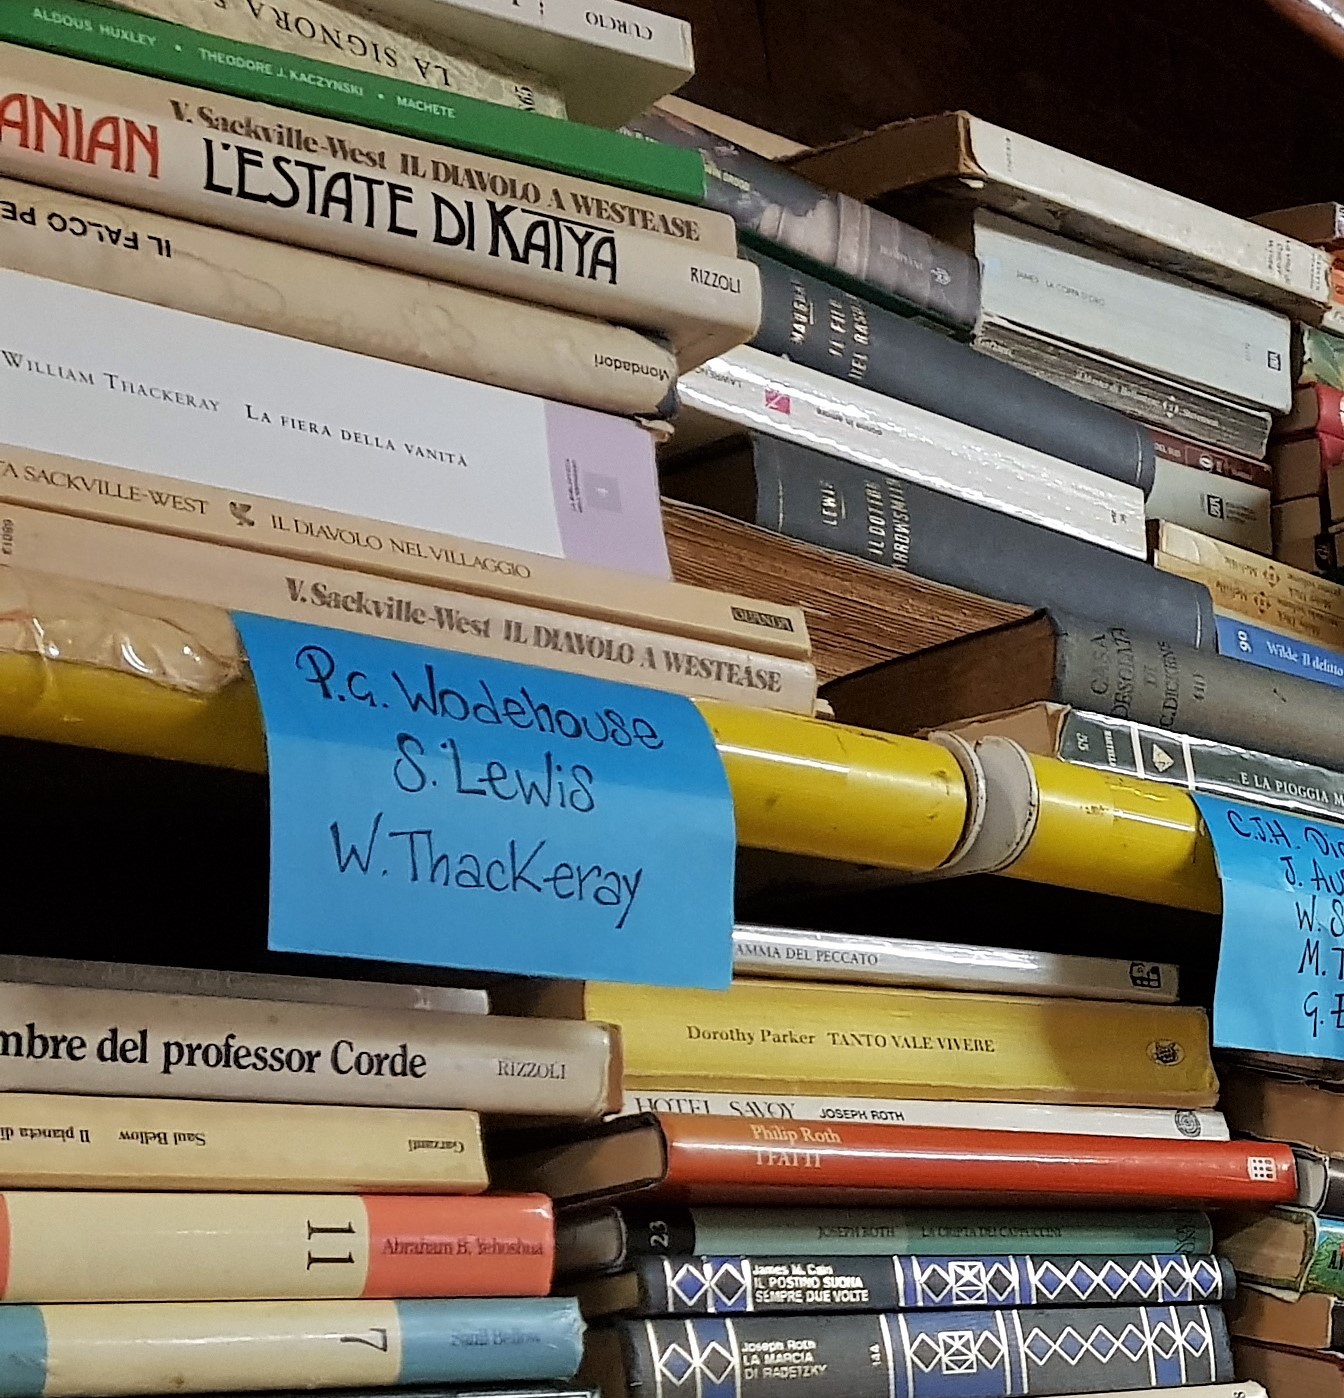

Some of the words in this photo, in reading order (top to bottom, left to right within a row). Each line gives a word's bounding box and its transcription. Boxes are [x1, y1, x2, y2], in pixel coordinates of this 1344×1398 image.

[32, 8, 94, 34] ALDOUS
[100, 24, 158, 49] HUXLEY
[200, 48, 271, 78] THEODORE
[288, 66, 365, 98] KACZYNSKI
[396, 94, 458, 119] MACHETE
[199, 101, 386, 170] Sackville-West
[400, 155, 429, 179] IL
[431, 160, 540, 204] DIAVOLO
[570, 188, 700, 242] WESTEASE
[202, 139, 418, 240] L'ESTATE
[432, 191, 476, 249] DI
[488, 206, 619, 285] KATYA
[690, 266, 741, 294] RIZZOLI
[592, 351, 670, 381] Mondadori
[245, 404, 275, 426] LA
[296, 645, 390, 709] P.G.
[98, 1029, 147, 1064] del
[161, 1031, 321, 1087] professor
[331, 1041, 427, 1078] Corde
[497, 1059, 566, 1080] RIZZOLI
[686, 1025, 755, 1048] Dorothy
[760, 1029, 815, 1046] Parker
[828, 1031, 884, 1049] TANTO
[890, 1035, 931, 1051] VALE
[936, 1036, 995, 1052] VIVERE
